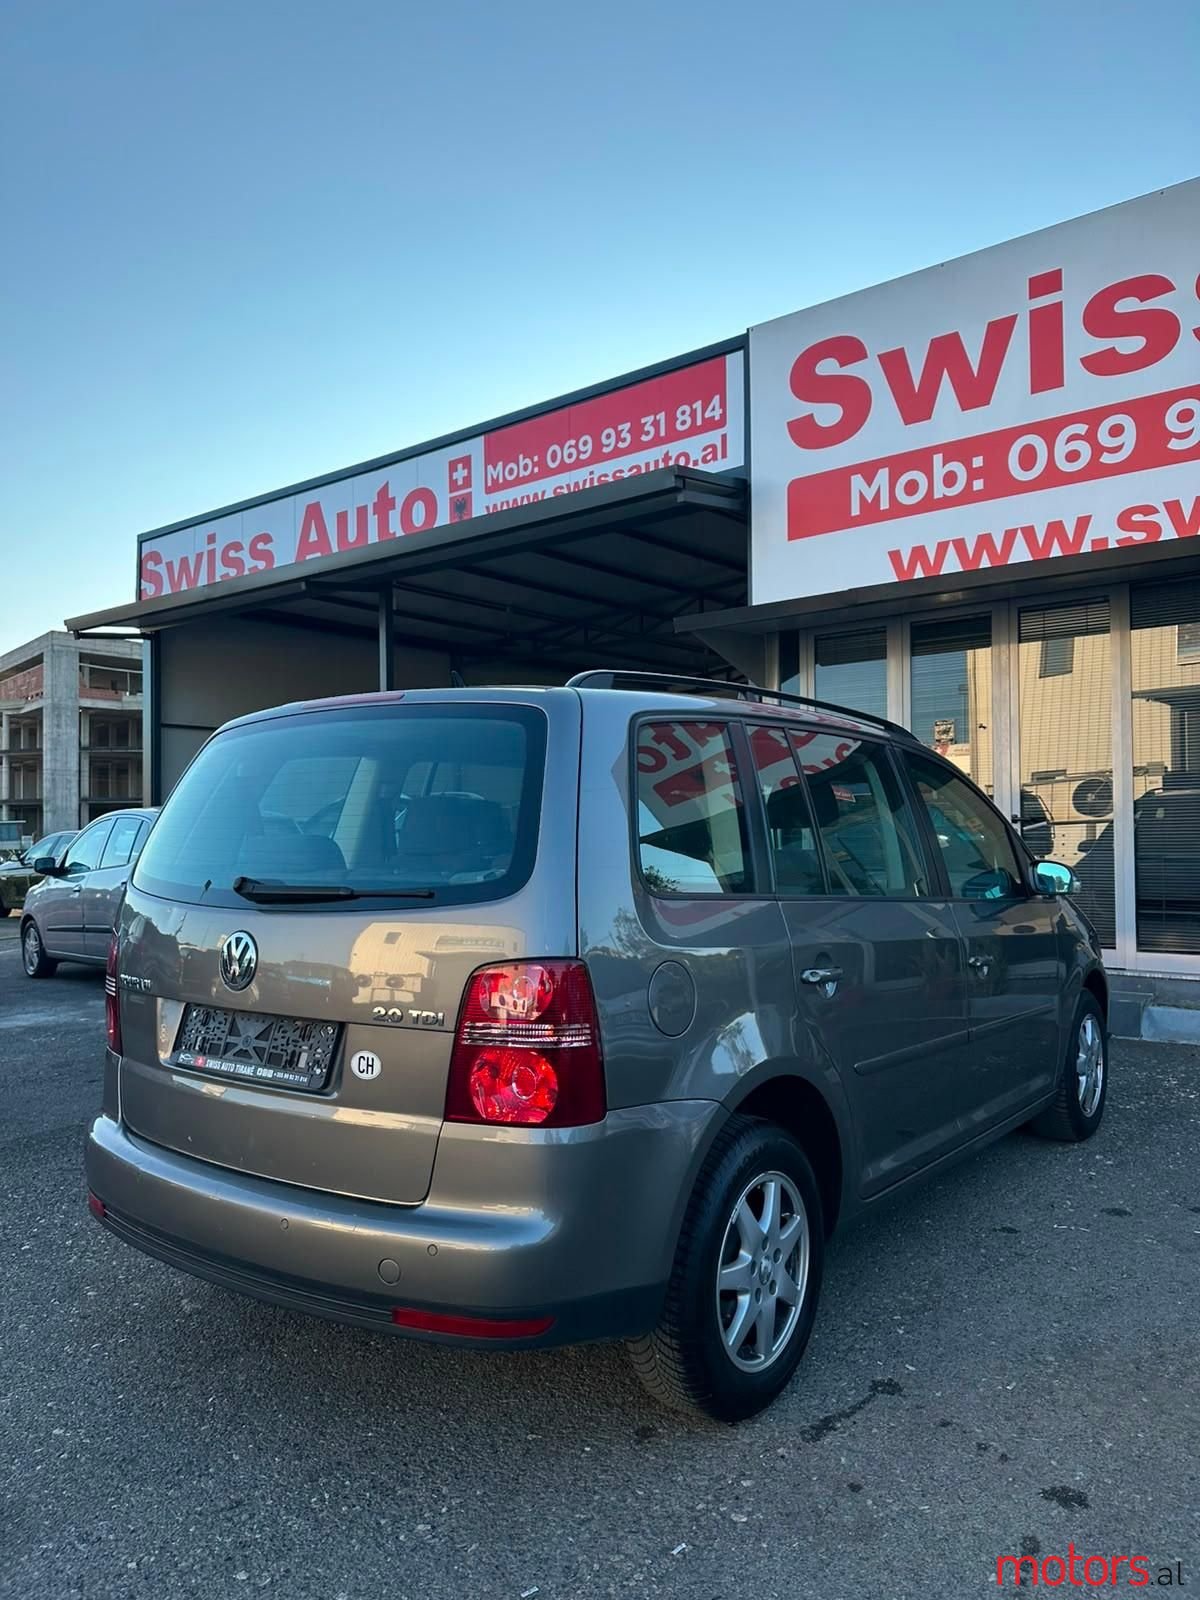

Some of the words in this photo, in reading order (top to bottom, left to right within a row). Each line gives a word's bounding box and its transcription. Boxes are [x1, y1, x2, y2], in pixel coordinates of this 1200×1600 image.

[786, 267, 1200, 450] Swis
[485, 433, 728, 514] wwwswissauto.al
[486, 453, 540, 487] Mob:
[546, 435, 593, 469] 069
[601, 421, 632, 454] 93
[640, 411, 668, 443] 31
[675, 394, 724, 432] 814
[849, 454, 985, 517] Mob:
[1007, 413, 1138, 482] 069
[140, 532, 276, 600] Swiss
[295, 480, 438, 563] Auto
[408, 1009, 445, 1027] TDI
[357, 1055, 375, 1075] CH
